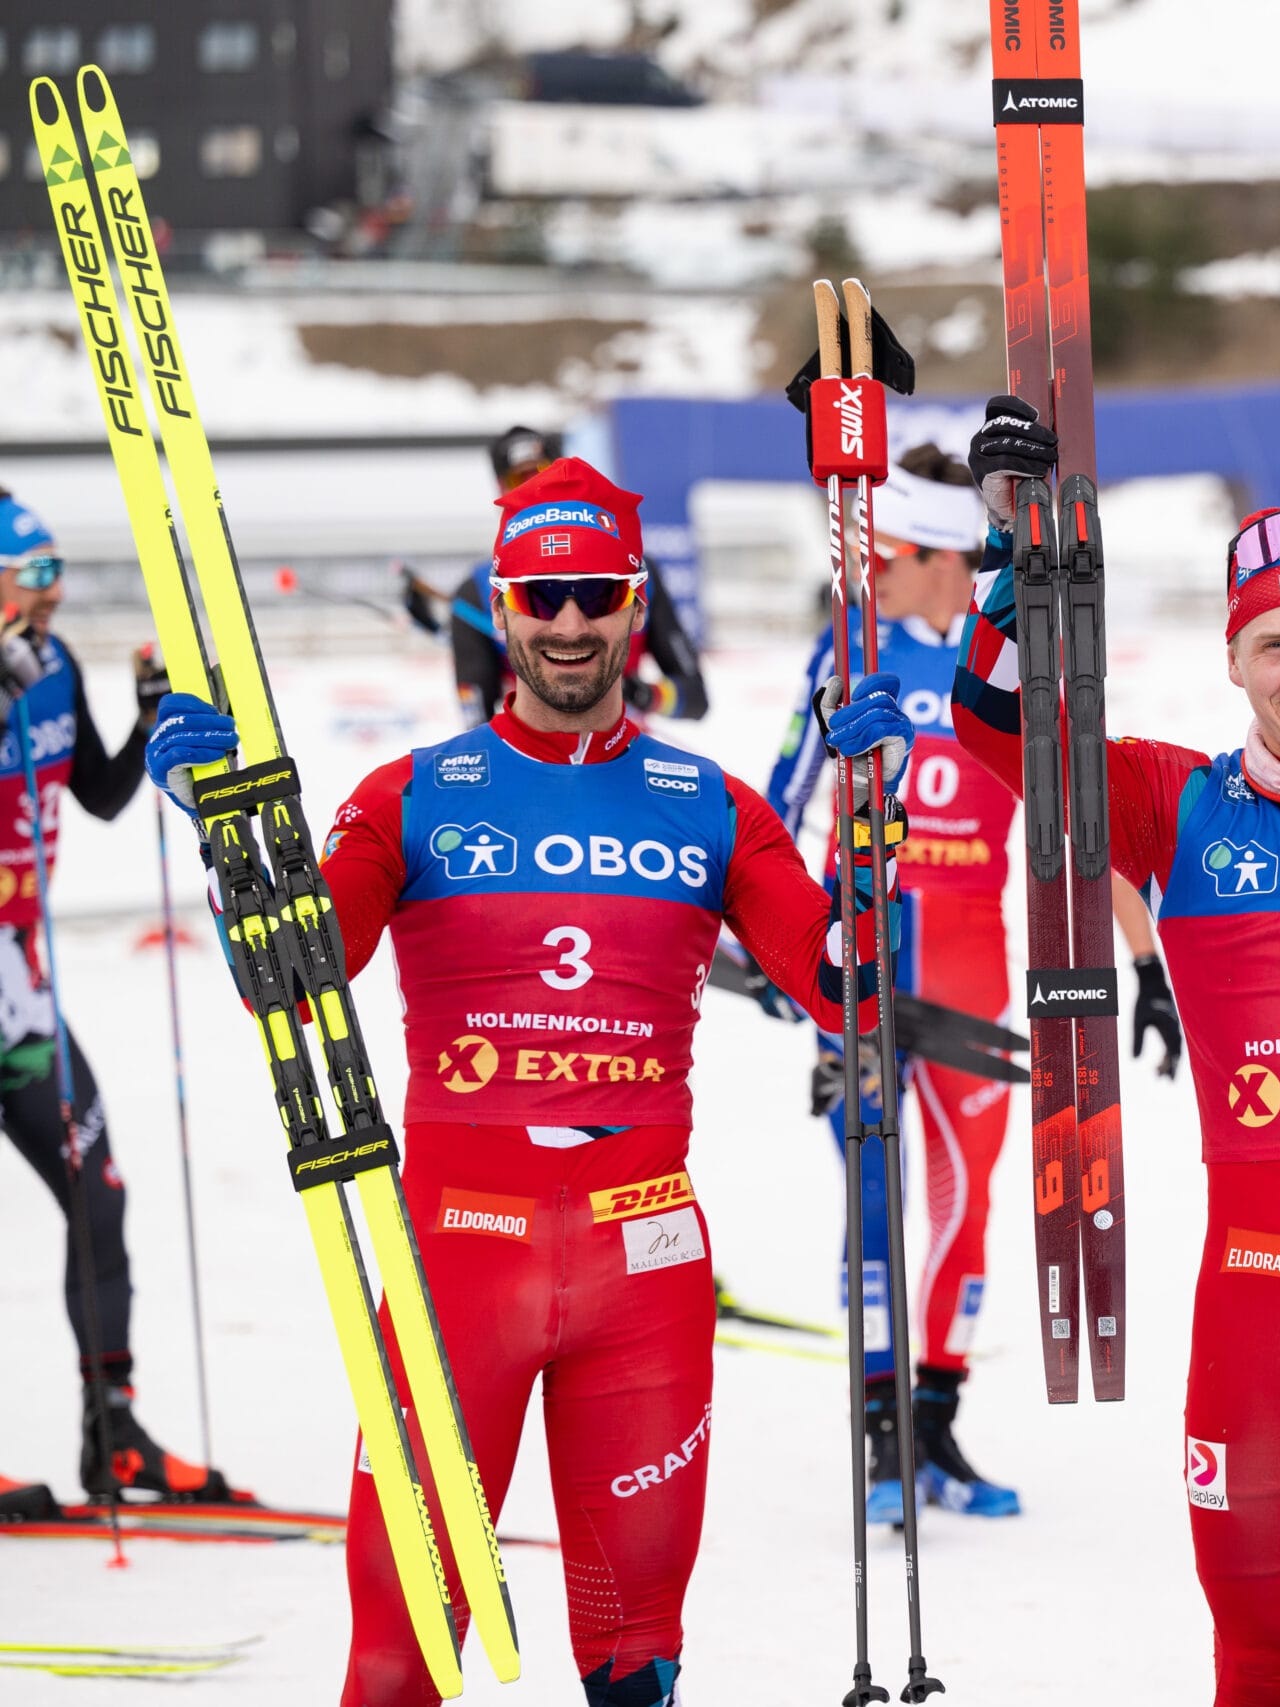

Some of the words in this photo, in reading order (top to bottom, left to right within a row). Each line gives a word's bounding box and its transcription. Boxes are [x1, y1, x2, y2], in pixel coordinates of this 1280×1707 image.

[1004, 0, 1020, 51] MIC
[1048, 0, 1065, 51] MIC
[1018, 98, 1078, 108] ATOMIC
[60, 201, 143, 437] FISCHER
[107, 187, 191, 420] FISCHER
[505, 508, 595, 539] SpareBank
[600, 515, 610, 528] 1
[199, 770, 292, 804] FISCHER
[443, 773, 482, 782] coop
[648, 776, 698, 792] coop
[534, 834, 708, 888] OBOS
[538, 925, 595, 991] 3
[1047, 988, 1108, 1001] ATOMIC
[466, 1012, 654, 1037] HOLMENKOLLEN
[515, 1049, 666, 1083] EXTRA
[295, 1139, 389, 1175] FISCHER
[610, 1178, 690, 1214] DHL
[443, 1208, 527, 1237] ELDORADO
[631, 1254, 678, 1270] MALLING
[610, 1416, 709, 1498] CRAFT
